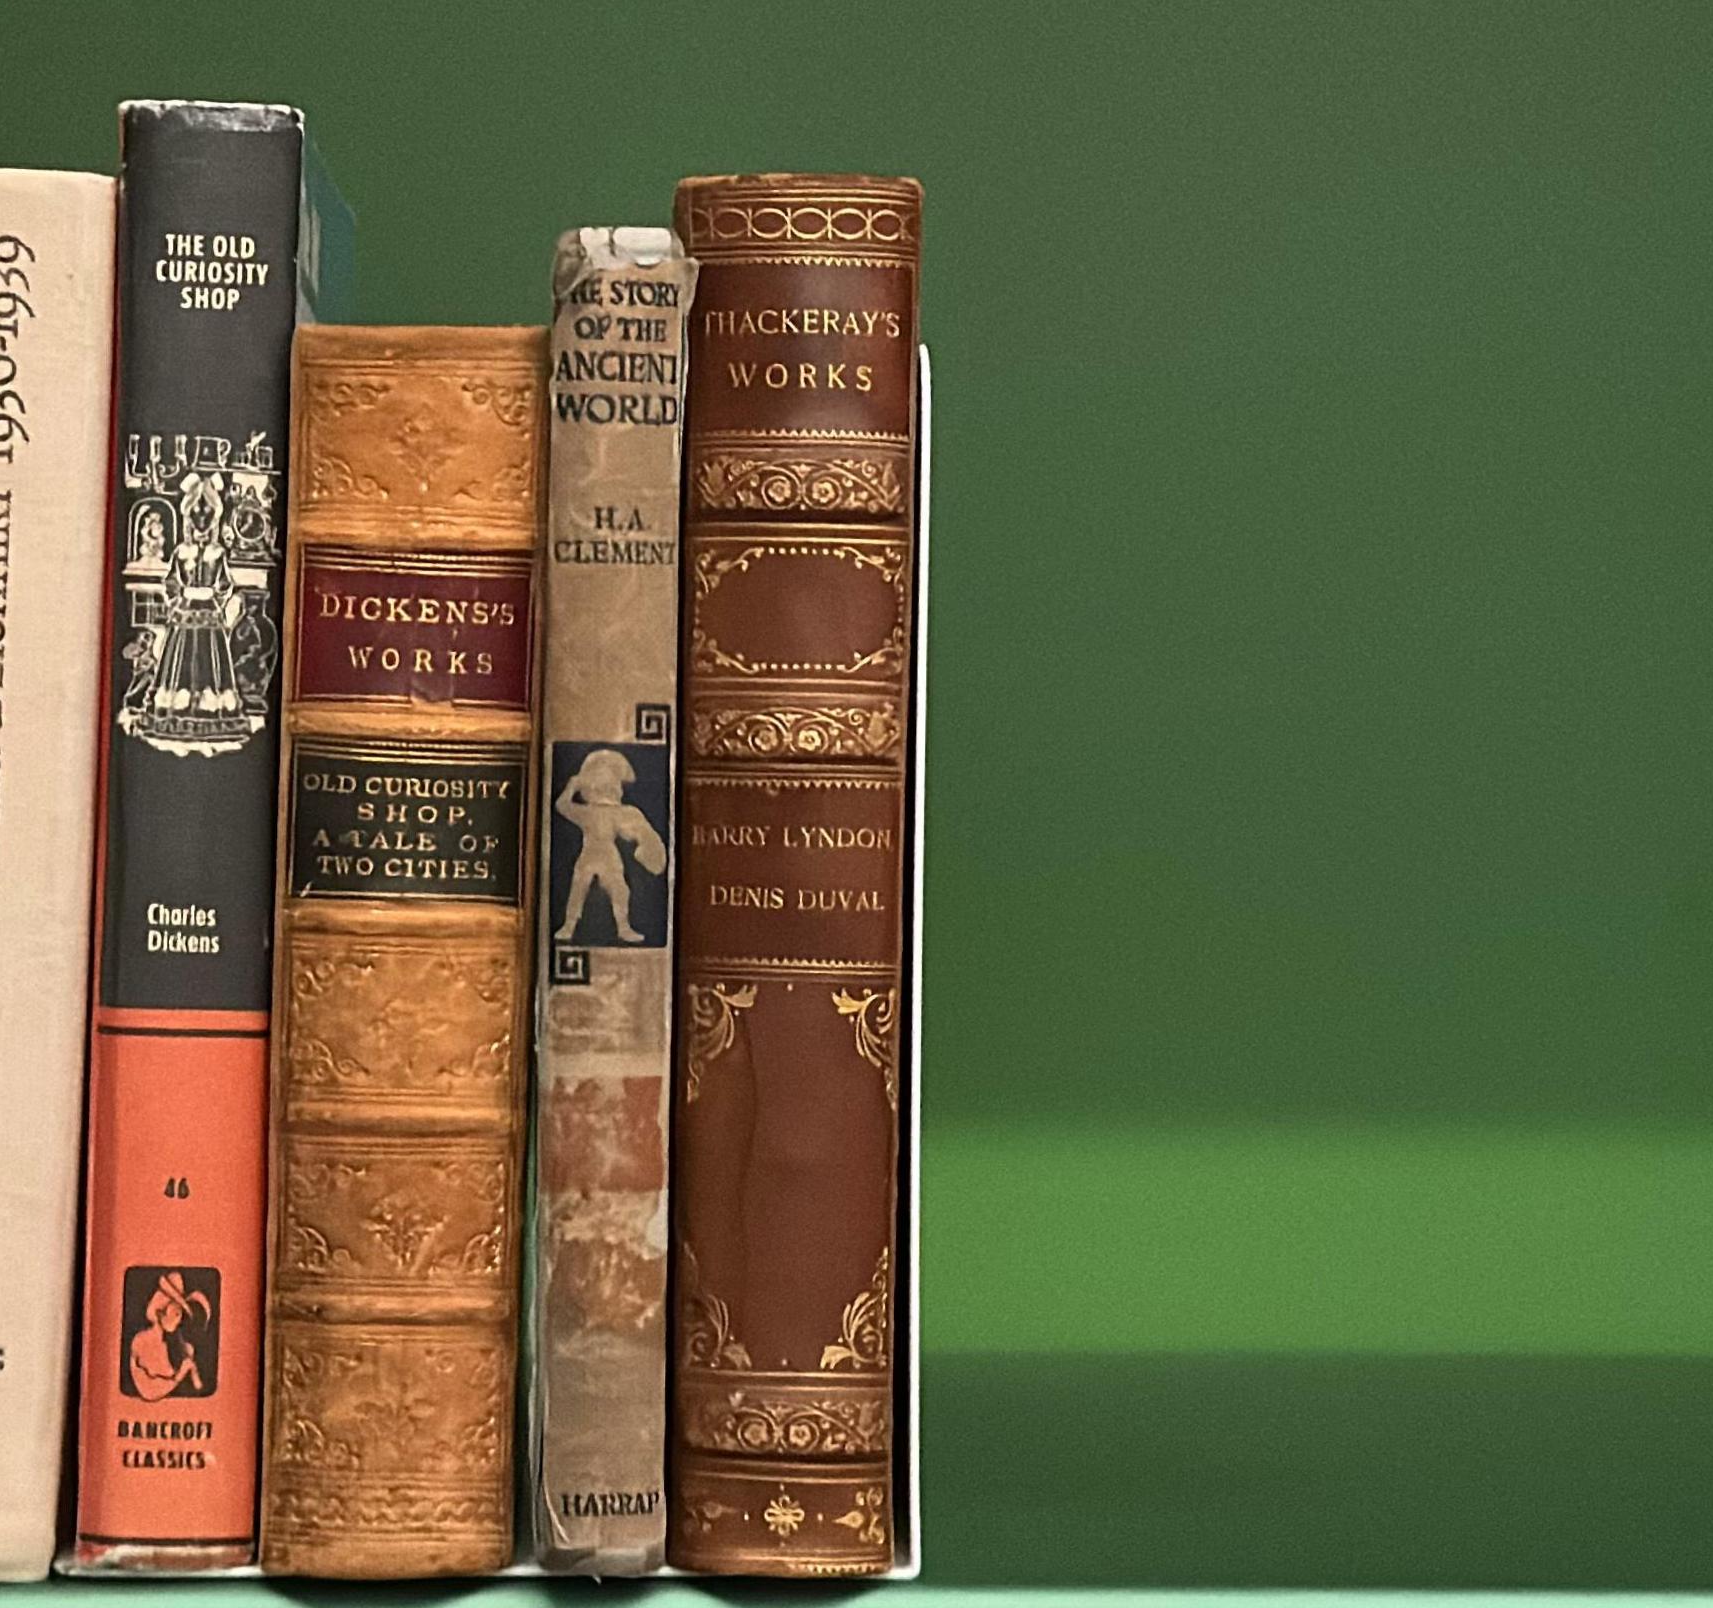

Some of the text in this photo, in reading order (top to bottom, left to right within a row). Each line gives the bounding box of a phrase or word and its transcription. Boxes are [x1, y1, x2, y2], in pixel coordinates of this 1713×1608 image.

[165, 233, 255, 259] THE OLD
[156, 259, 268, 285] CURIOSITY
[180, 287, 240, 310] SHOP
[566, 277, 680, 308] HE STORY
[574, 313, 667, 342] OF THE
[704, 308, 900, 337] THACKERAY'S
[555, 350, 677, 385] ANCIENT
[728, 362, 873, 392] WORKS
[556, 393, 678, 426] WORLD
[554, 540, 675, 565] CLEMENT
[320, 593, 515, 625] DICKENS'S
[348, 645, 493, 674] WORKS
[303, 773, 510, 799] OLD CURIOSITY
[358, 802, 473, 826] SHOP.
[313, 828, 499, 853] A TALE OF
[692, 825, 892, 850] BARRY LYNDON
[317, 855, 374, 876] TWO
[710, 885, 885, 912] DENIS DUVAL
[147, 903, 216, 926] Charles
[148, 930, 219, 953] Dickens
[164, 1176, 190, 1199] 46
[118, 1420, 212, 1439] BANCROFT
[122, 1450, 206, 1469] CLASSICS
[561, 1489, 660, 1517] HARRAP
